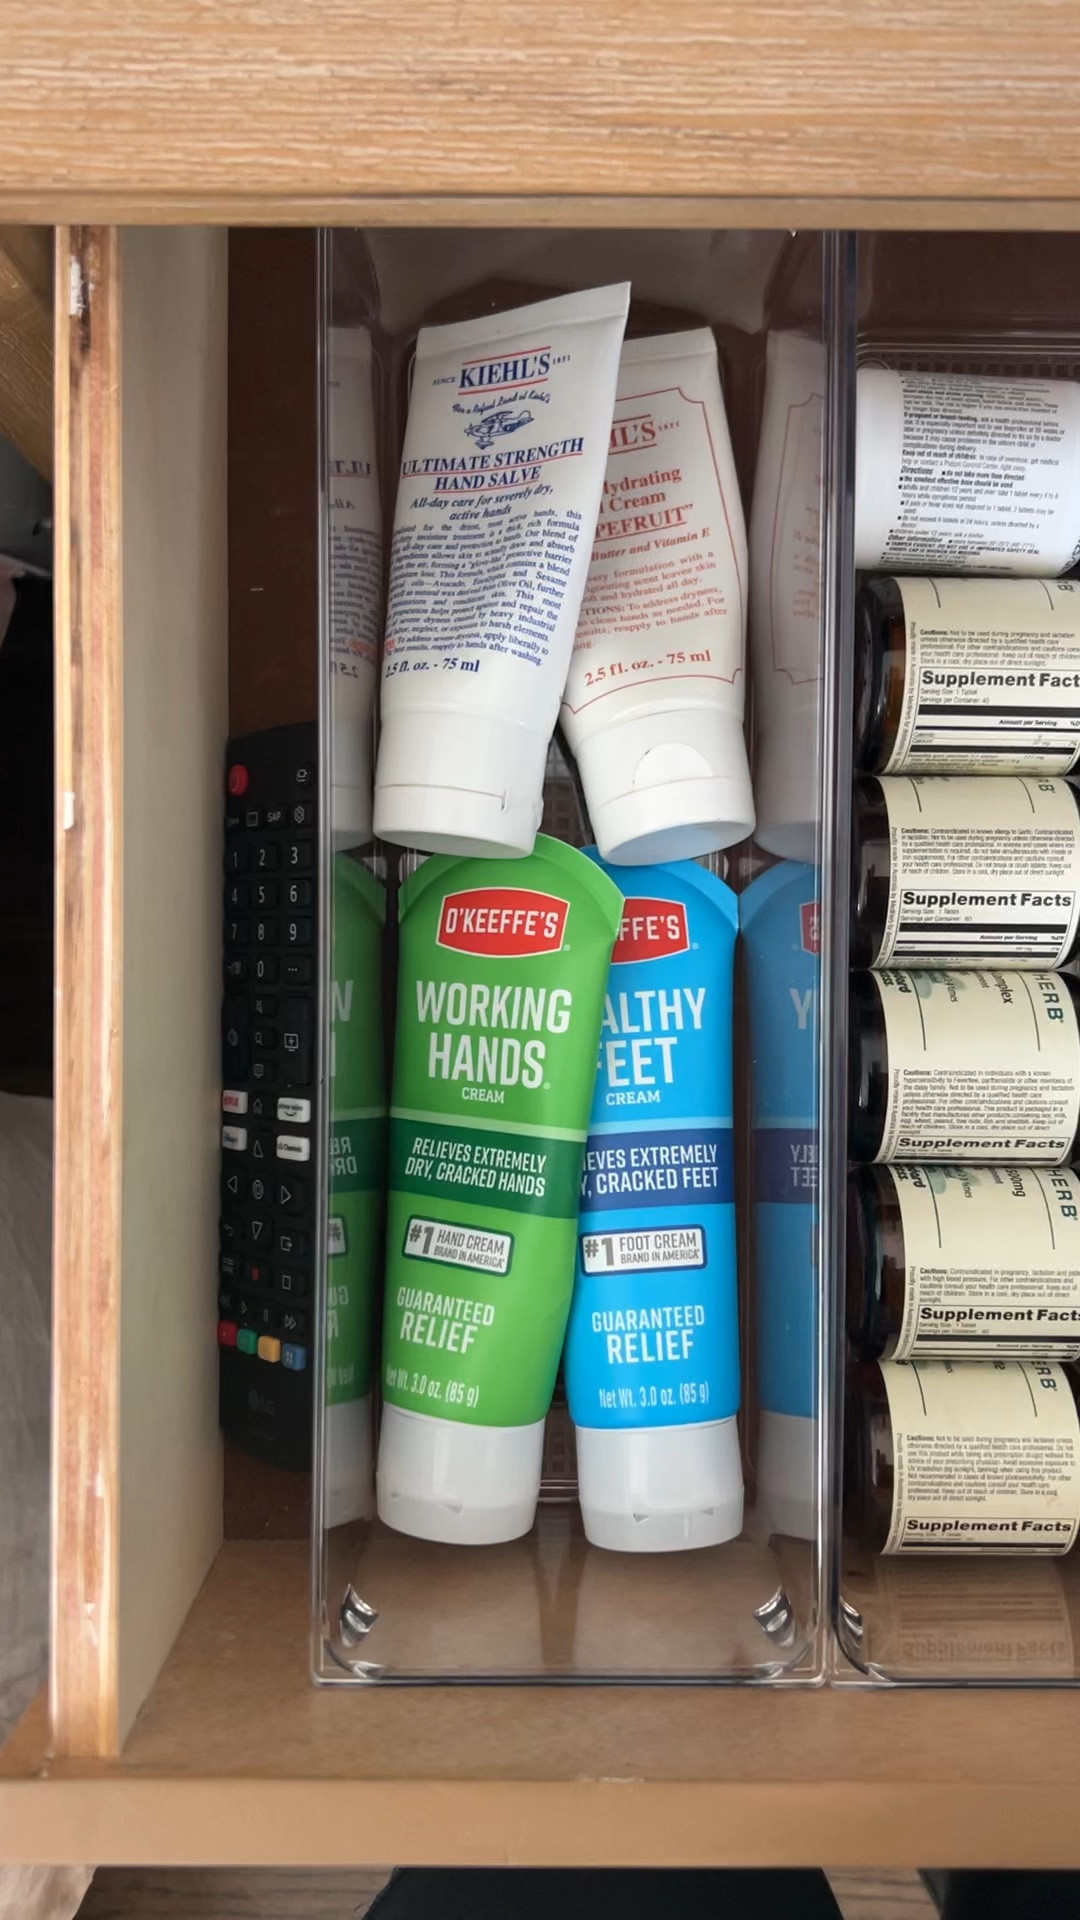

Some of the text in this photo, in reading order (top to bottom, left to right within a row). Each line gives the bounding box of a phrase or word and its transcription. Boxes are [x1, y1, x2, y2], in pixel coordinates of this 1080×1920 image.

[459, 353, 551, 388] KIEHL'S
[402, 437, 584, 476] ULTIMATE STRENGTH
[434, 466, 542, 491] HAND SALVE
[411, 484, 554, 510] All-day care for severely dry,
[610, 492, 666, 512] Cream
[449, 504, 513, 521] active hands
[566, 510, 582, 520] this
[542, 529, 566, 539] blend
[547, 518, 580, 531] formula
[547, 540, 575, 553] absorb
[628, 542, 652, 555] and
[654, 532, 698, 550] Vitamin
[702, 527, 711, 538] E
[544, 550, 572, 564] barrier
[614, 561, 675, 578] formulation
[680, 552, 703, 565] with
[536, 571, 567, 587] Sesame
[547, 562, 570, 576] blend
[634, 562, 716, 586] scent leaves skin
[516, 590, 534, 600] This
[519, 580, 535, 590] Oil,
[537, 582, 564, 598] further
[602, 577, 703, 602] and hydrated all day.
[501, 600, 558, 621] and repair the
[590, 597, 725, 626] clean hands needed. For
[642, 596, 679, 610] address
[488, 620, 550, 642] harsh elements.
[490, 610, 556, 632] heavy industrial
[614, 621, 652, 634] reapply
[670, 612, 700, 624] hands
[704, 608, 728, 617] after
[465, 640, 542, 666] hands after washing.
[484, 632, 549, 656] apply liberally to
[399, 660, 410, 673] fl.
[413, 661, 430, 671] oz.
[442, 658, 458, 670] 75
[460, 660, 480, 672] ml
[584, 650, 712, 687] 2.5 fl. oz. 75 ml
[922, 670, 1035, 688] Supplement
[268, 811, 281, 822] SAP
[233, 847, 298, 868] 1 2 3
[231, 884, 298, 904] 4 5 6
[904, 892, 1072, 908] Supplement Facts
[232, 922, 296, 941] 7 8 9
[446, 907, 559, 938] O'KEEFFE'S
[257, 960, 264, 978] 0
[416, 980, 573, 1034] WORKING
[428, 1032, 546, 1089] HANDS
[461, 1086, 505, 1104] CREAM
[606, 1090, 661, 1106] CREAM
[412, 1136, 547, 1174] RELIEVES EXTREMELY
[898, 1138, 1066, 1150] Supplement Facts
[630, 1144, 718, 1168] EXTREMELY
[405, 1156, 546, 1197] DRY, CRACKED HANDS
[596, 1168, 678, 1194] CRACKED
[682, 1166, 718, 1189] FEET
[409, 1224, 434, 1255] #1
[437, 1229, 505, 1256] HAND CREAM
[620, 1232, 697, 1252] FOOT CREAM
[433, 1244, 458, 1260] BRAND
[458, 1250, 467, 1262] IN
[584, 1237, 614, 1266] #1
[620, 1252, 650, 1264] BRAND
[652, 1250, 661, 1262] IN
[397, 1286, 496, 1326] GUARANTEED
[920, 1307, 1034, 1321] Supplement
[592, 1304, 706, 1332] GUARANTEED
[400, 1314, 479, 1354] RELIEF
[607, 1330, 694, 1364] RELIEF
[411, 1372, 428, 1394] 3.0
[428, 1380, 442, 1398] oz.
[445, 1380, 465, 1403] (85
[466, 1384, 480, 1408] g)
[599, 1380, 710, 1408] Net Wt. 3.0 oz. (85 g)
[906, 1520, 1072, 1532] Supplement Facts
